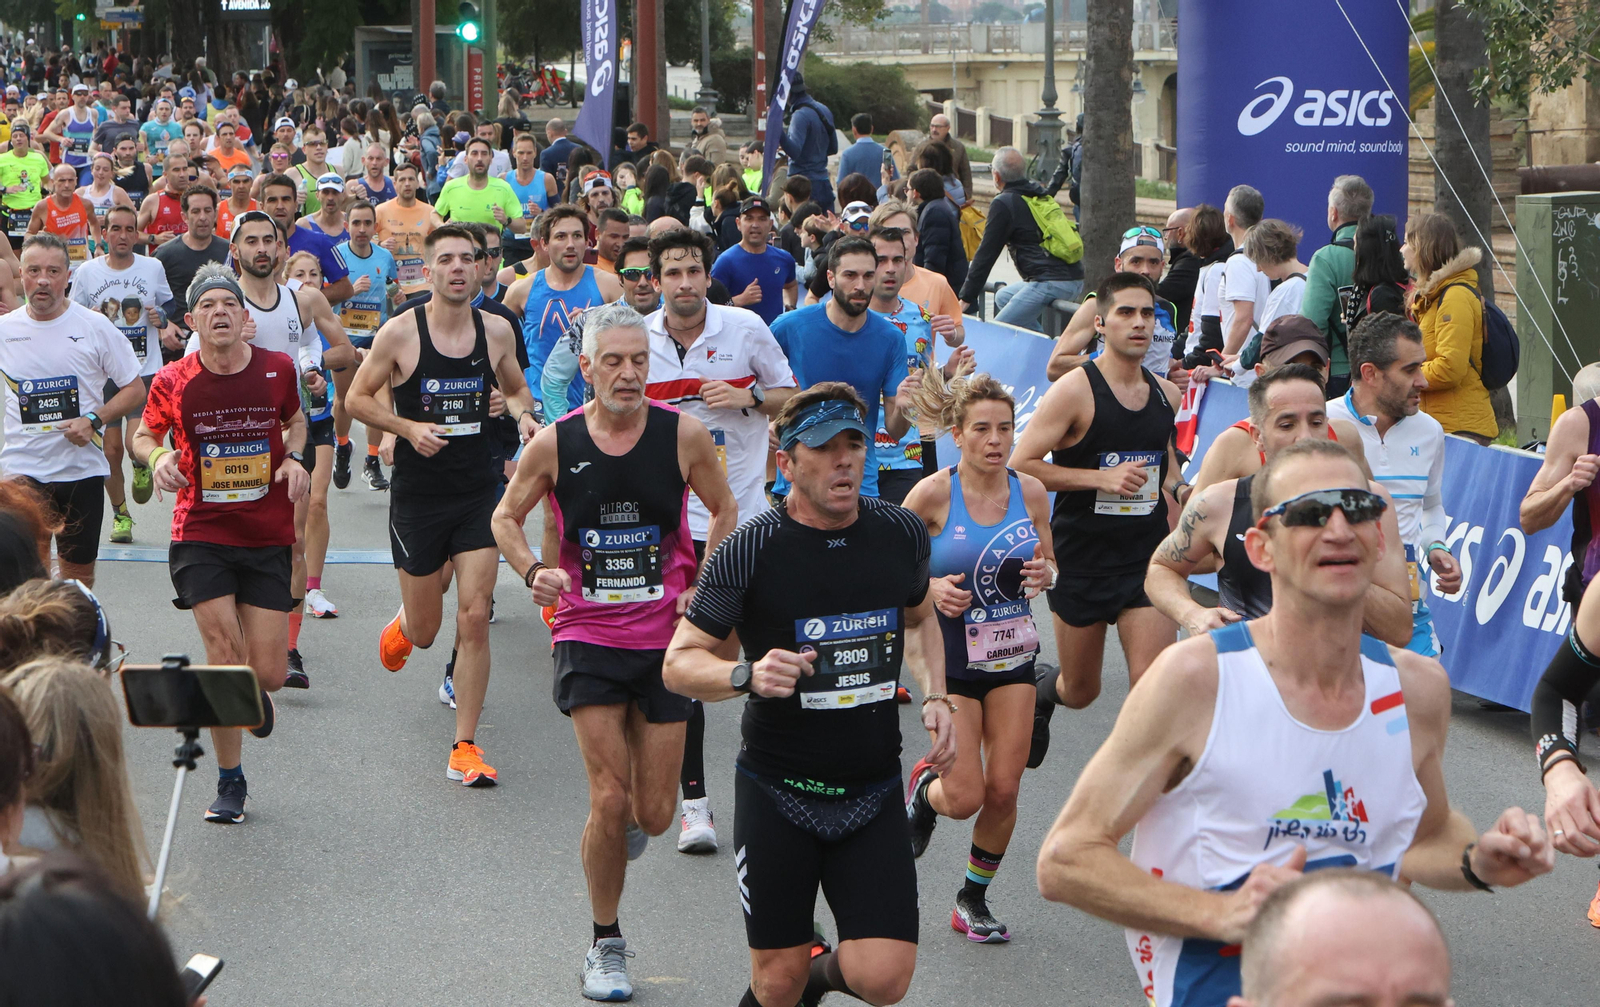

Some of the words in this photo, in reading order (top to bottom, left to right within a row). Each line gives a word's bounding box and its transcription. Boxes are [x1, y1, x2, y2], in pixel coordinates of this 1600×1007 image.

[474, 68, 482, 98] PASEO
[1294, 90, 1394, 126] asics
[1285, 140, 1325, 152] sound
[1326, 140, 1356, 154] mind,
[1358, 140, 1388, 152] sound
[1388, 140, 1404, 155] body
[90, 279, 121, 303] Ariadna
[124, 279, 130, 288] y
[132, 276, 148, 296] Vega
[37, 379, 71, 390] ZURICH
[444, 381, 477, 390] ZURICH
[38, 398, 59, 408] 2425
[442, 400, 463, 410] 2160
[39, 412, 62, 421] OSKAR
[216, 407, 247, 415] MARATÓN
[445, 415, 460, 423] NEIL
[225, 444, 263, 454] ZURICH
[225, 464, 249, 474] 6019
[233, 478, 263, 488] MANUEL
[602, 514, 637, 523] RUNNER
[605, 531, 649, 545] ZURICH
[992, 549, 1006, 560] A
[606, 558, 634, 570] 3356
[596, 576, 646, 587] FERNANDO
[980, 565, 996, 597] POC
[992, 604, 1022, 618] ZURICH
[832, 615, 887, 632] ZURICH
[993, 628, 1015, 642] 7747
[834, 648, 868, 666] 2809
[987, 645, 1024, 659] CAROLINA
[835, 673, 870, 687] JESUS
